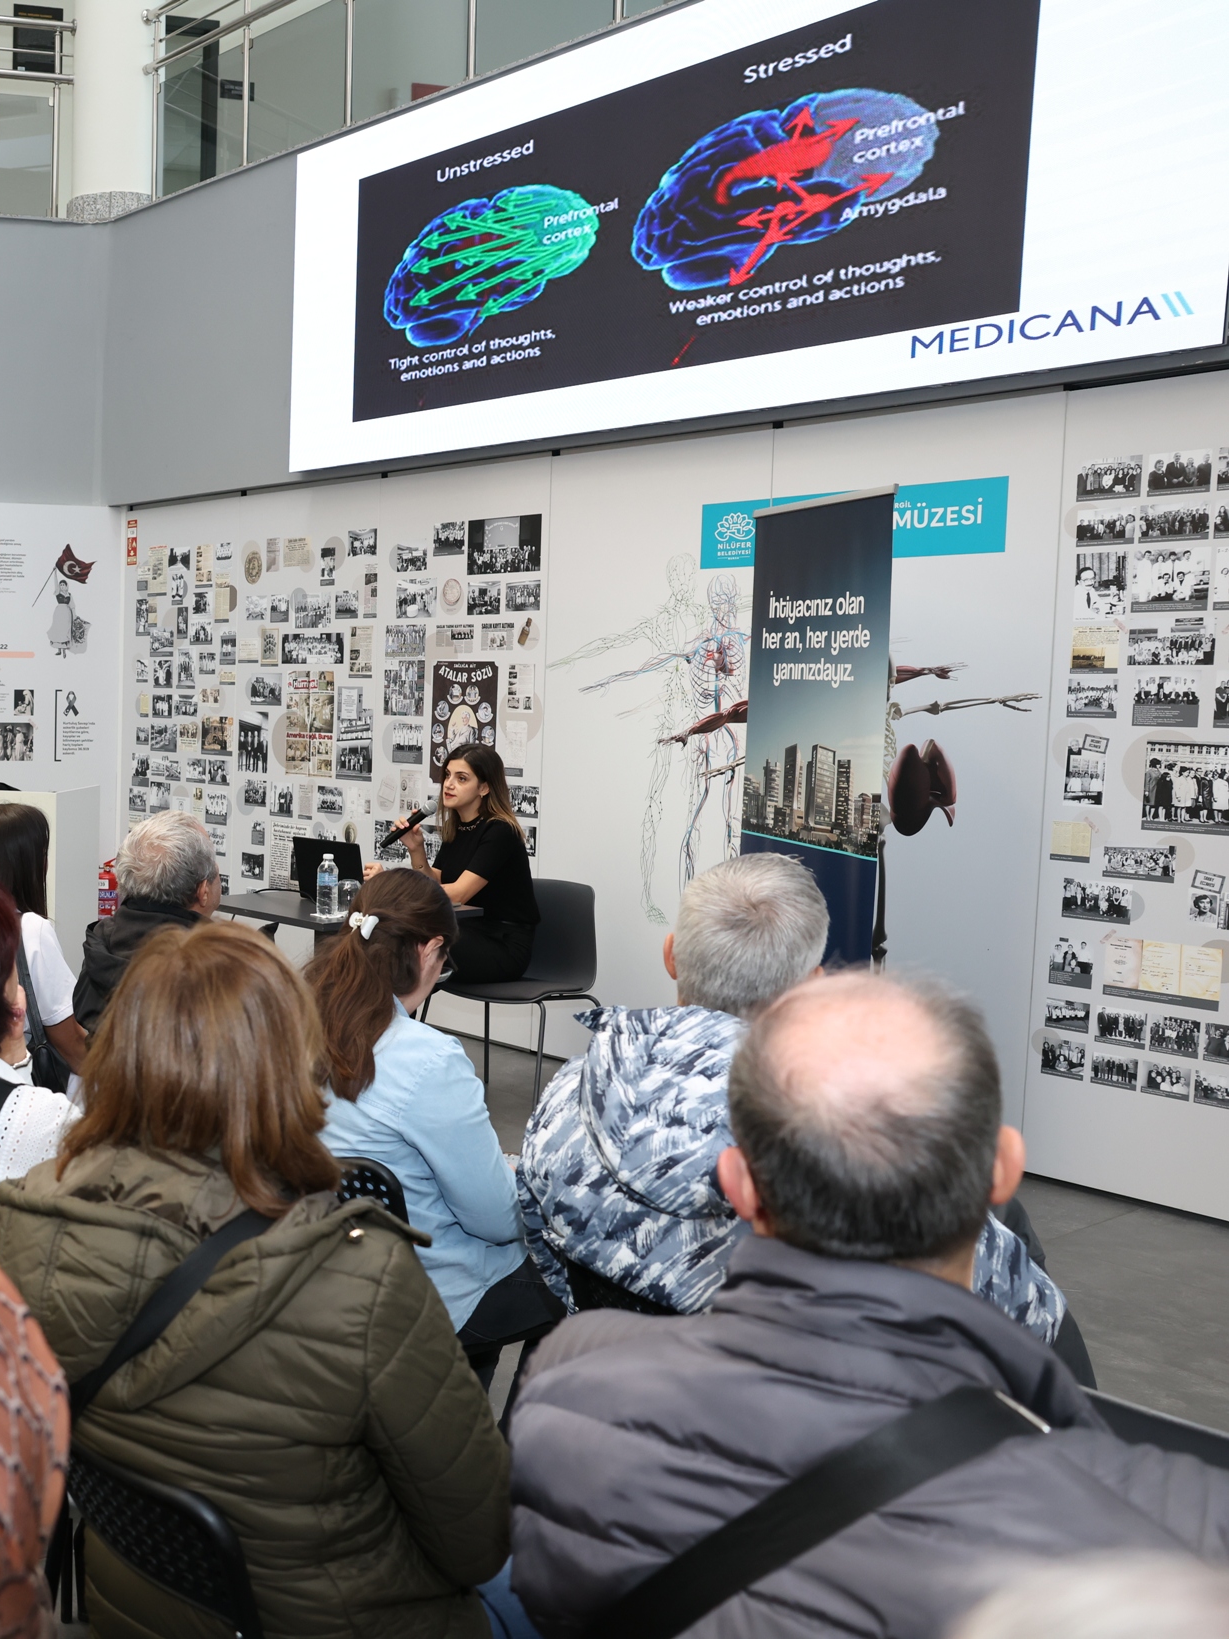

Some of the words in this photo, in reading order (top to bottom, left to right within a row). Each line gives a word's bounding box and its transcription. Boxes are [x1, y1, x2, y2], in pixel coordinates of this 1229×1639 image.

[743, 33, 853, 84] Stressed
[854, 101, 966, 145] Prefrontal
[436, 139, 534, 182] Unstressed
[852, 135, 925, 164] cortex
[543, 198, 618, 229] Prefrontal
[839, 187, 948, 222] Amygdala
[542, 224, 592, 246] cortex
[669, 290, 734, 315] Weaker
[738, 274, 808, 300] control
[812, 266, 834, 285] of
[839, 250, 942, 280] thoughts,
[696, 299, 782, 326] emotions
[786, 290, 824, 310] and
[828, 275, 906, 301] actions
[910, 296, 1162, 359] MEDICANA
[389, 354, 420, 371] Tight
[422, 345, 469, 364] control
[472, 340, 487, 352] of
[489, 328, 556, 350] thoughts,
[400, 362, 460, 382] emotions
[462, 356, 487, 370] and
[490, 345, 542, 364] actions
[892, 497, 983, 530] MÜZESİ
[717, 541, 752, 550] NİLÜFER
[768, 590, 833, 624] İhtiyacınız
[836, 591, 865, 616] olan
[762, 628, 782, 649] her
[784, 631, 803, 653] an,
[806, 626, 828, 649] her
[831, 624, 871, 656] yerde
[293, 679, 318, 689] Hürriet
[438, 666, 468, 683] ATALAR
[470, 665, 493, 682] SÖZÜ
[773, 658, 854, 688] yanınızdayız.
